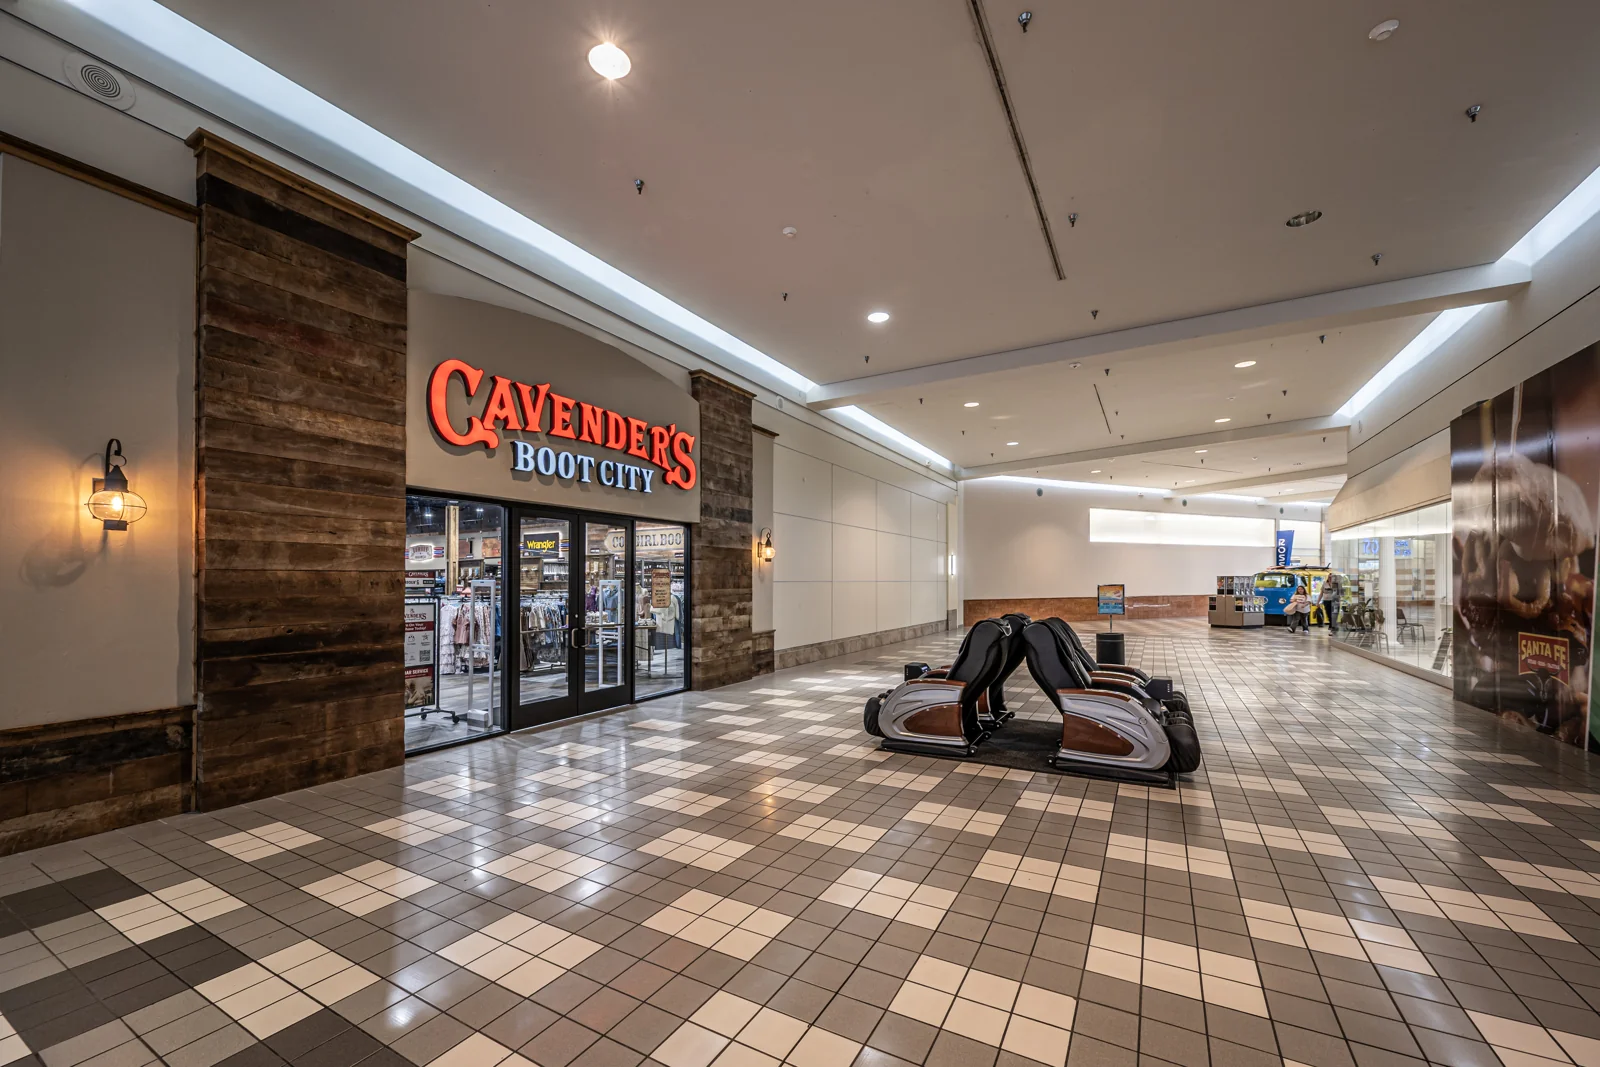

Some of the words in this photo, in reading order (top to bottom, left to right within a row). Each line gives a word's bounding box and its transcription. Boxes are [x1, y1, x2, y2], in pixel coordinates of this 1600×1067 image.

[428, 358, 697, 490] CAVENDER'S
[512, 440, 595, 483] BOOT
[599, 460, 654, 493] CITY
[527, 540, 555, 552] Wrangler
[660, 533, 684, 546] BOO
[1521, 639, 1552, 660] SANTA
[1553, 644, 1566, 670] FE
